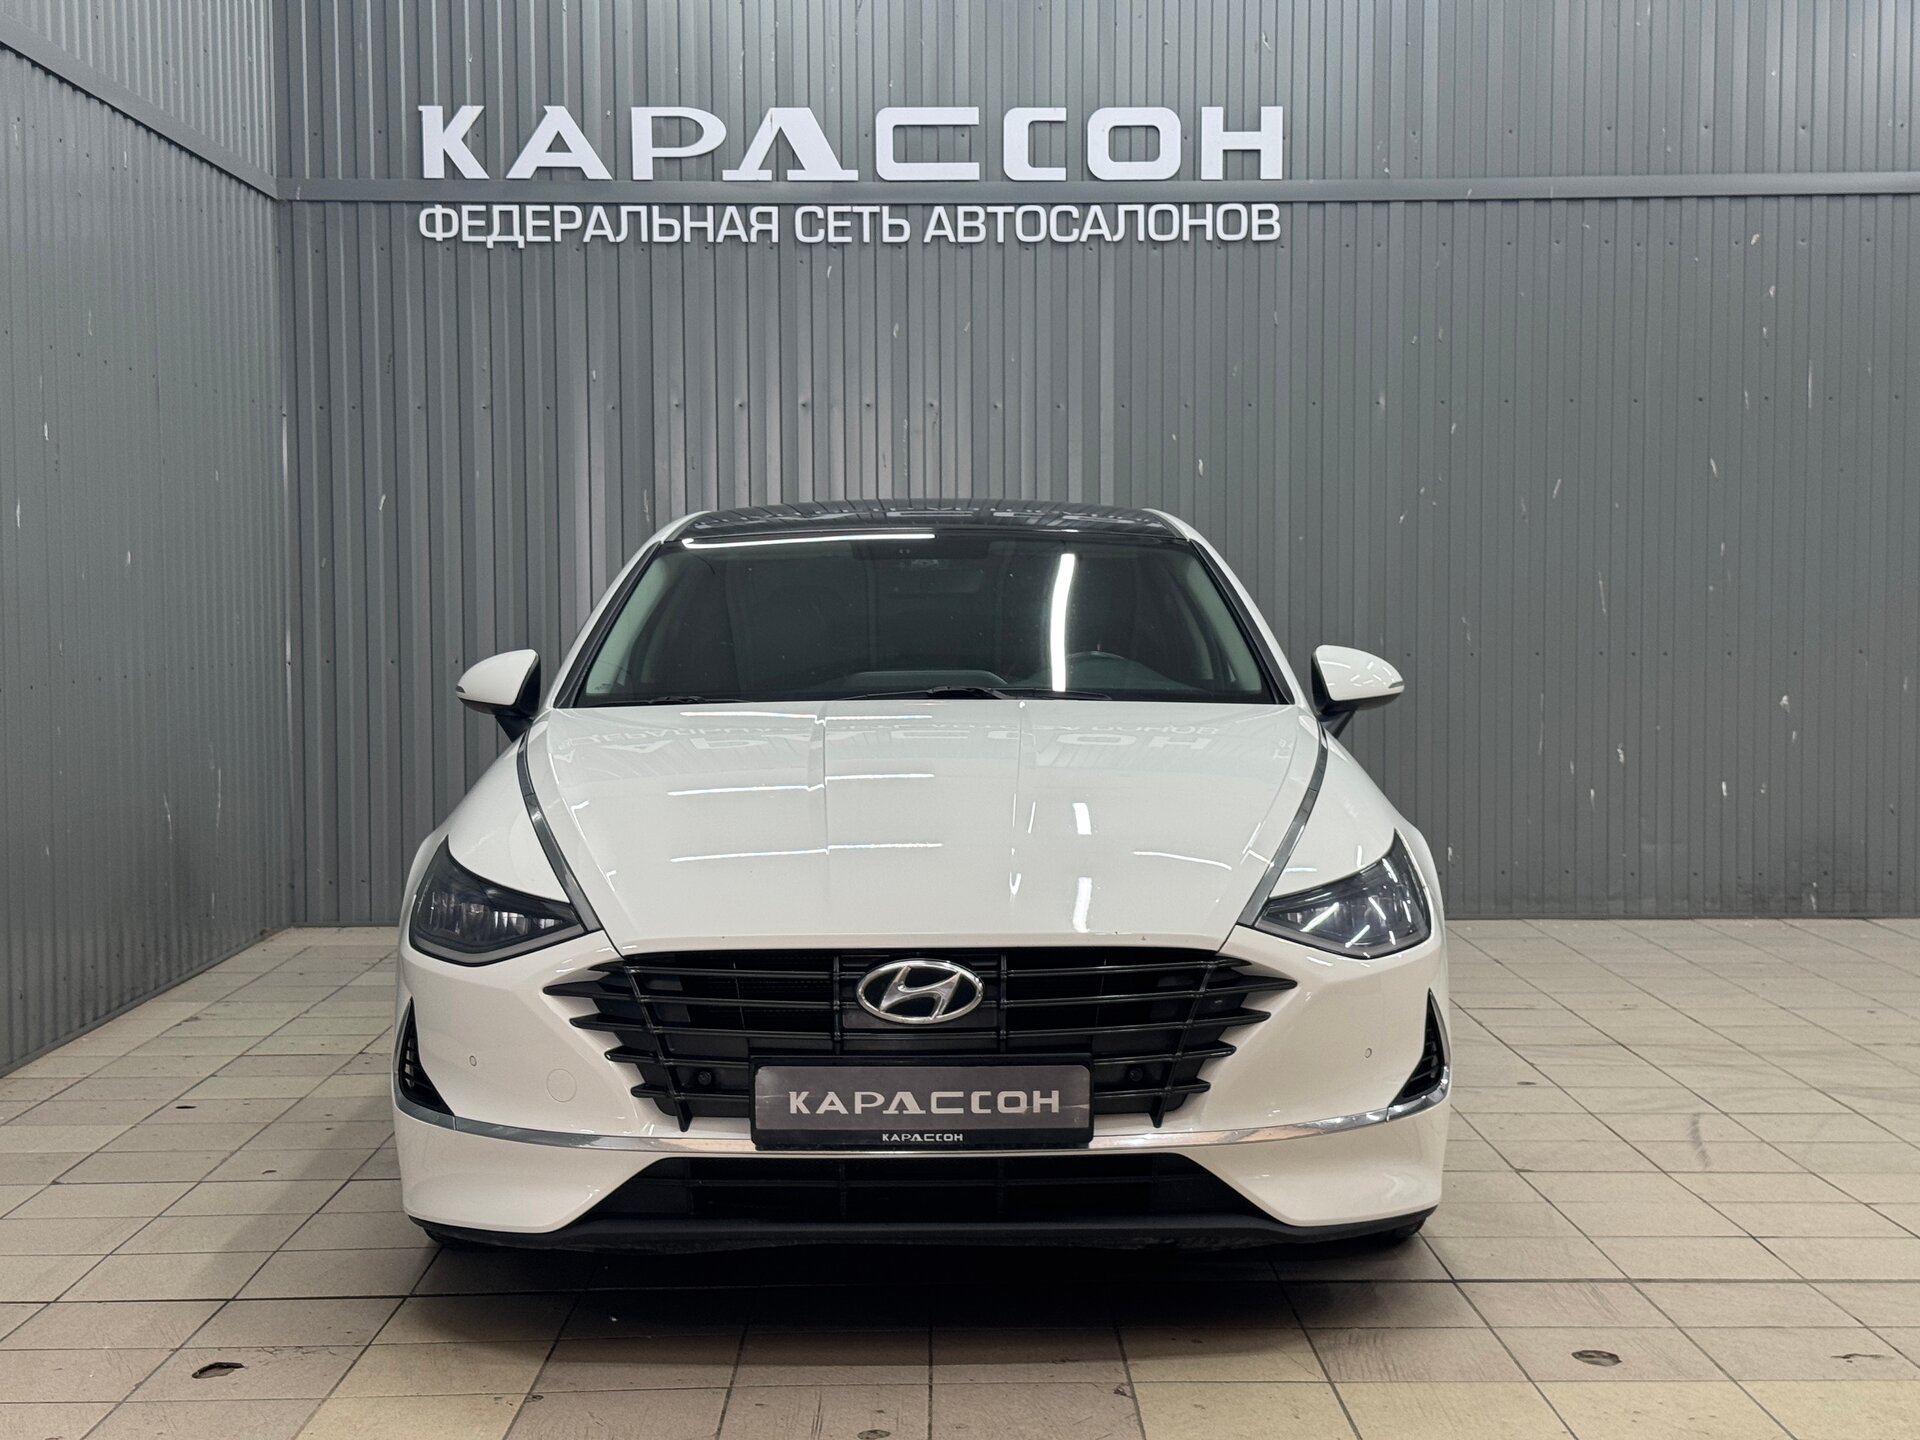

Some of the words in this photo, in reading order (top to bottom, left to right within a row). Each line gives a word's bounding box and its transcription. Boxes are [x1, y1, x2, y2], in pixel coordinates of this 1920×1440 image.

[419, 204, 780, 249] ФЕДЕРАЛЬНАЯ
[794, 204, 911, 244] СЕТЬ
[923, 203, 1281, 244] АВТОСАЛОНОВ
